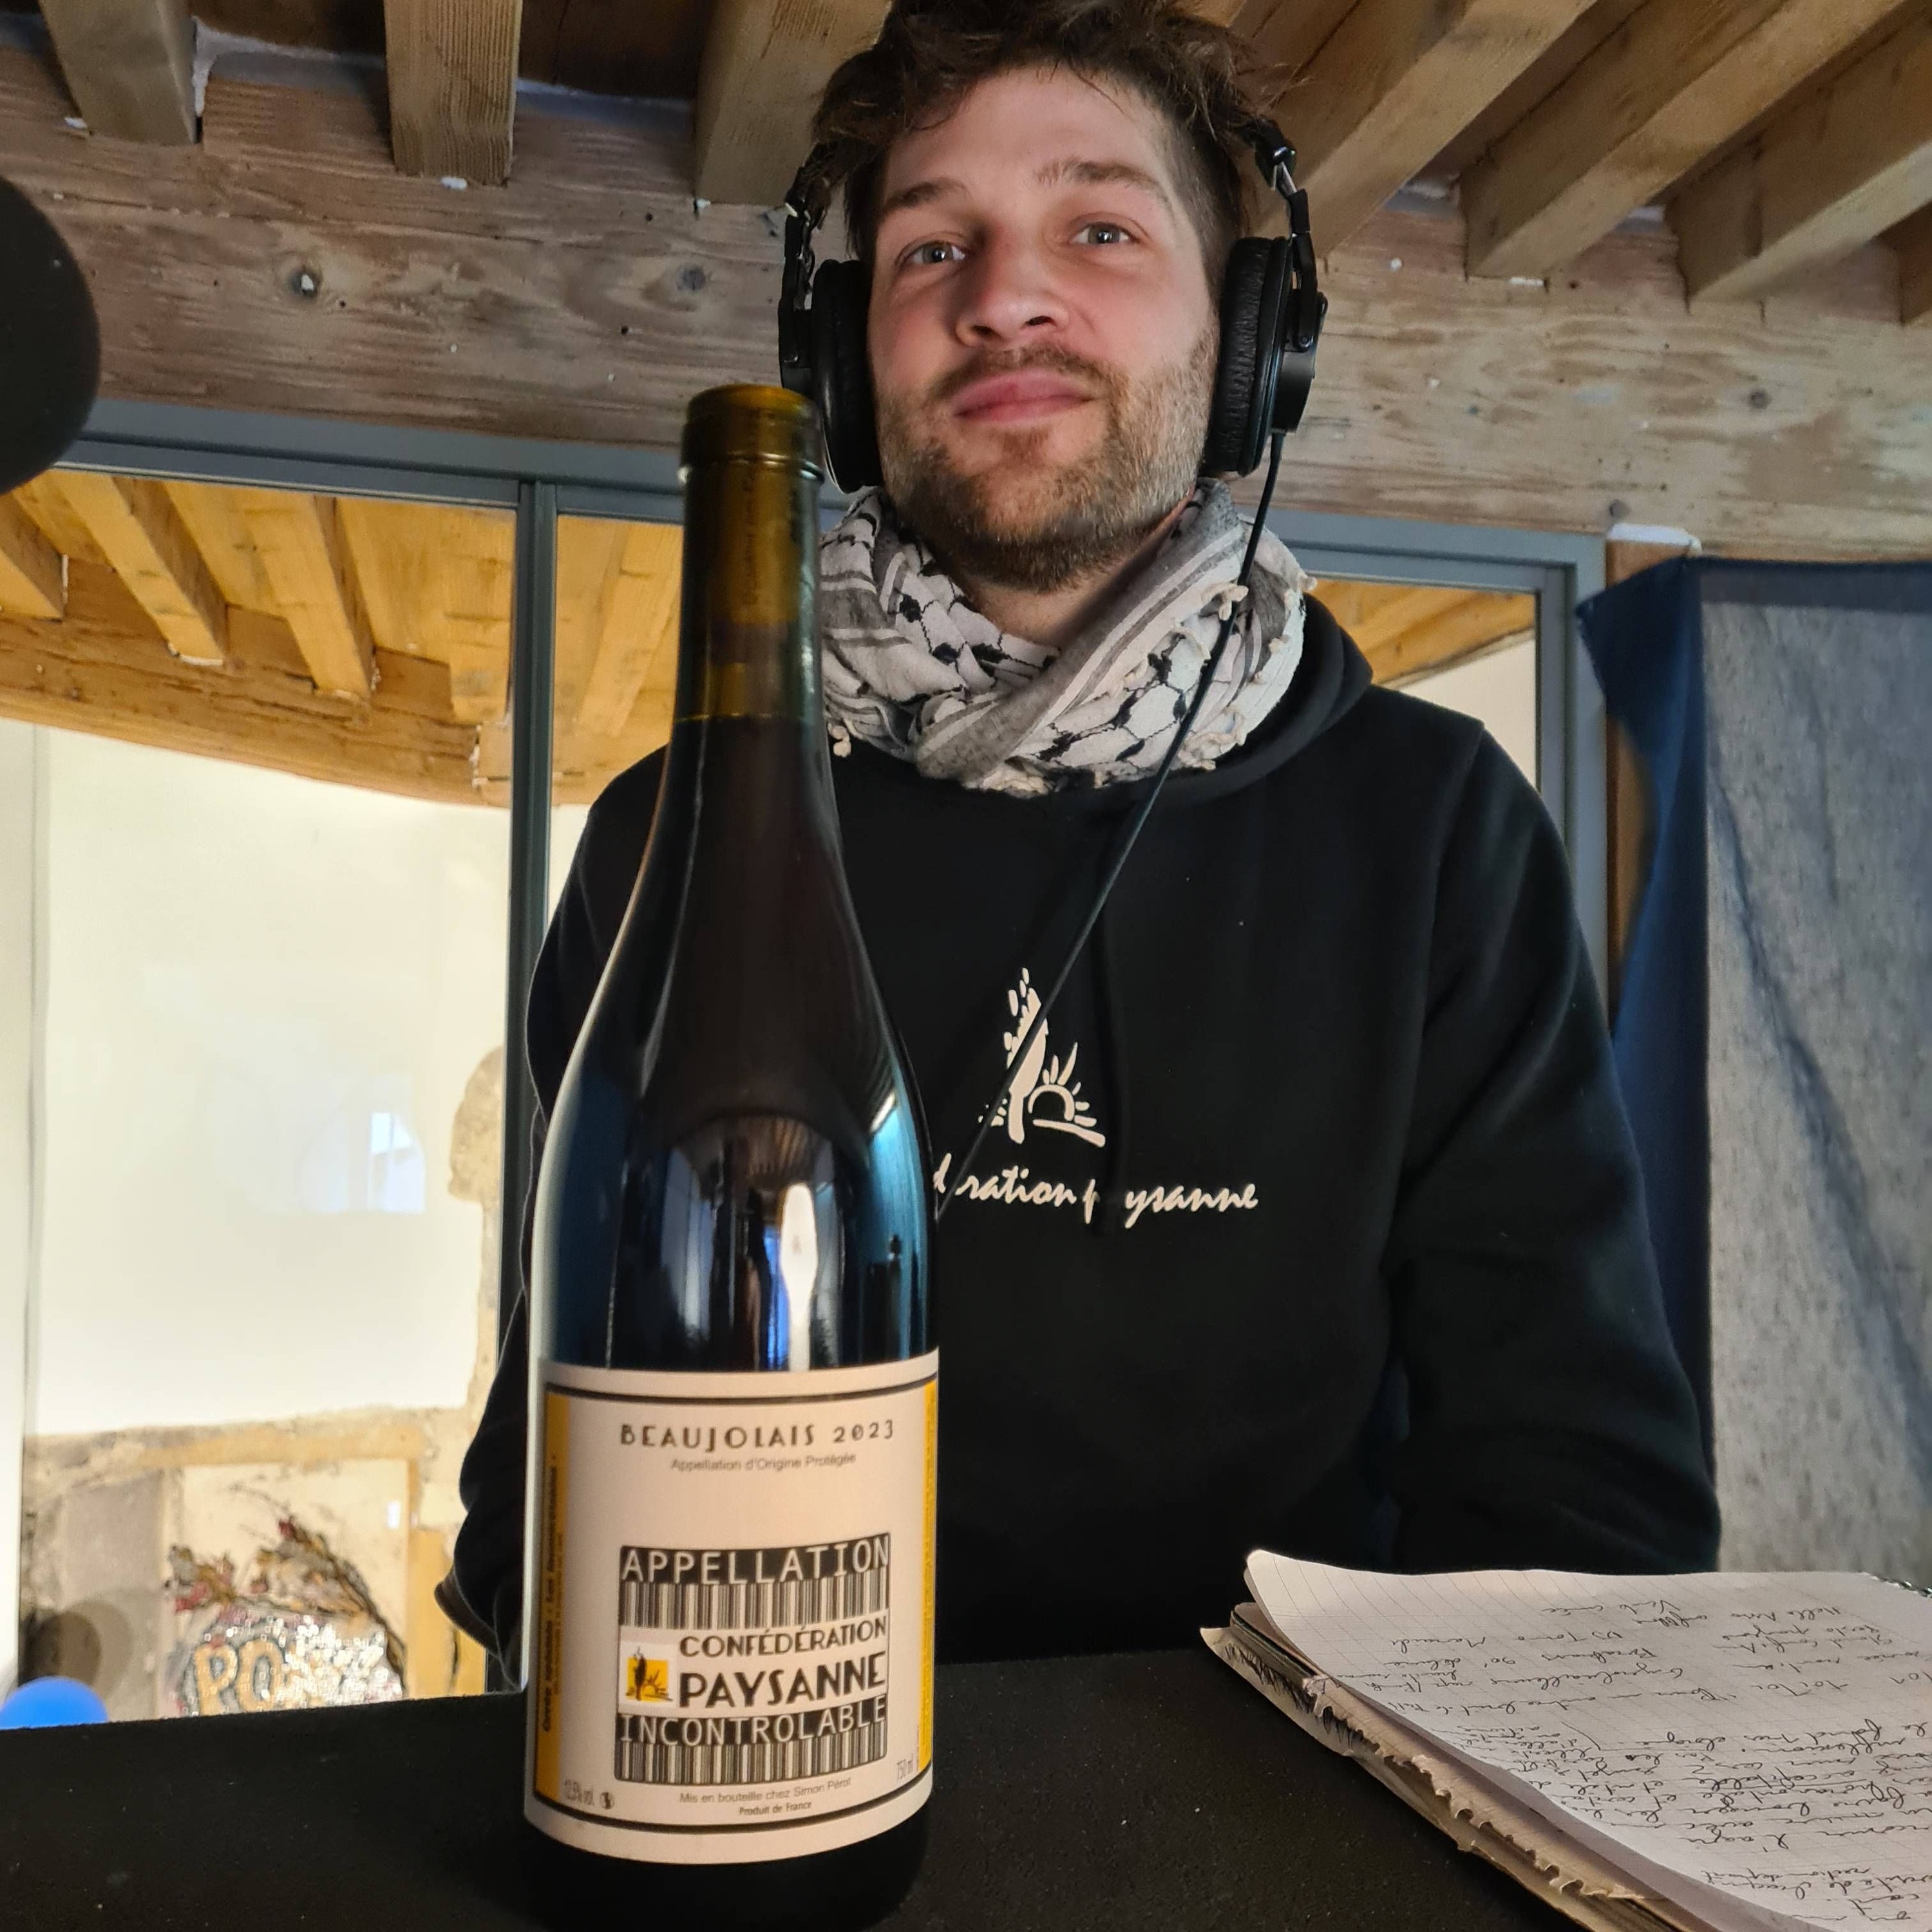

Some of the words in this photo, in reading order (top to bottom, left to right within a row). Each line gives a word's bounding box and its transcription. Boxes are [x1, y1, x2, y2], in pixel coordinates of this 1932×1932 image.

[1083, 1179, 1258, 1229] pysanne
[620, 1423, 815, 1452] BEAUJOLAIS
[833, 1419, 894, 1443] 2023
[671, 1458, 742, 1472] Appellation
[746, 1456, 799, 1471] d'Origine
[620, 1535, 889, 1584] APPELLATION
[679, 1614, 887, 1658] CONFÉDÉRATION
[679, 1651, 887, 1709] PAYSANNE
[620, 1695, 886, 1747] INCONTROLABLE
[680, 1793, 698, 1803] Mis
[719, 1792, 762, 1803] bouteille
[766, 1788, 791, 1799] chez
[794, 1784, 824, 1797] Simon
[739, 1806, 770, 1816] Produit
[773, 1804, 782, 1814] de
[786, 1801, 812, 1812] France
